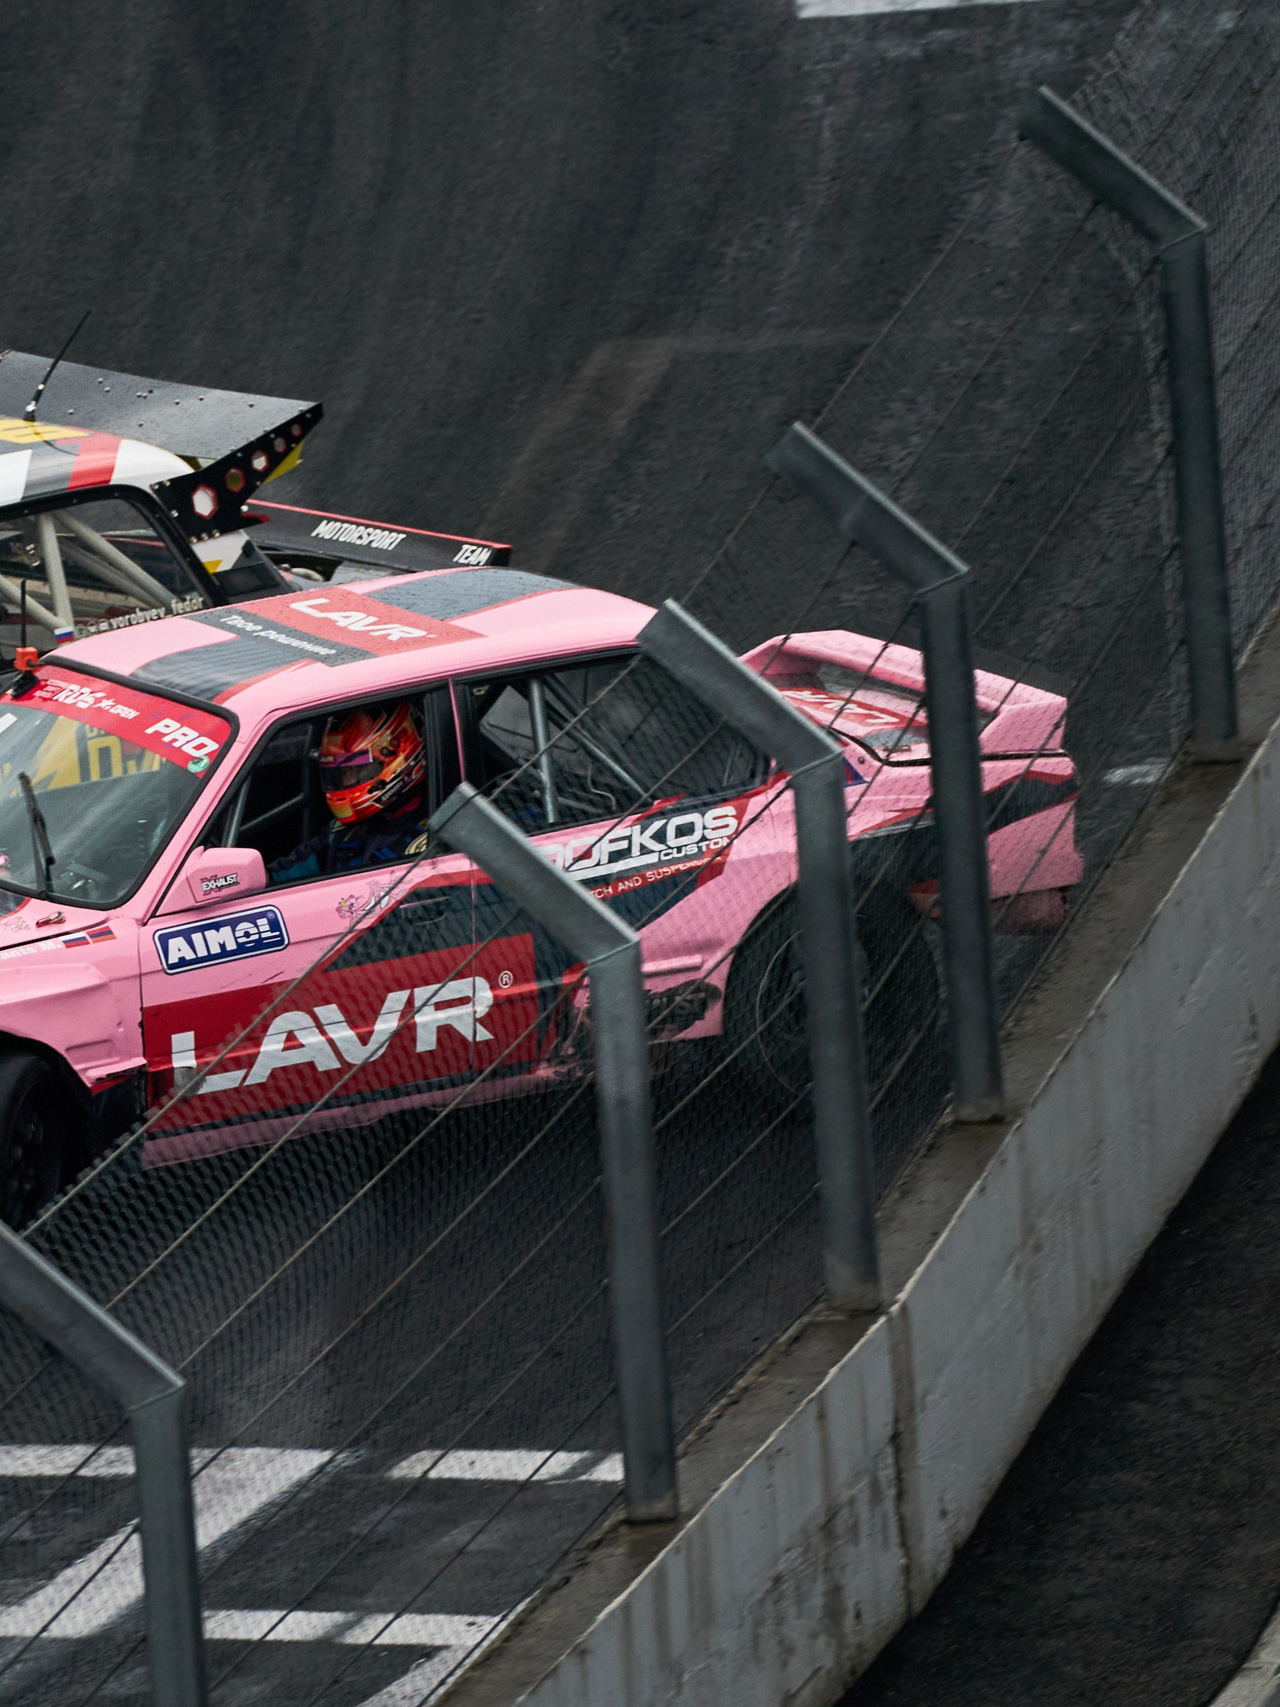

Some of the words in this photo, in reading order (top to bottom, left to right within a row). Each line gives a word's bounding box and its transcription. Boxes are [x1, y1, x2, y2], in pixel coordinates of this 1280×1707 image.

[311, 520, 407, 551] MOTORSPORT
[452, 544, 494, 566] TEAM
[220, 614, 263, 632] Твое
[289, 598, 428, 641] LAVR
[53, 684, 106, 708] RDS
[109, 704, 140, 720] OPEN
[144, 718, 220, 757] PRO
[202, 873, 238, 891] EXHAUST
[618, 877, 642, 892] AND
[168, 917, 282, 965] AIMOL
